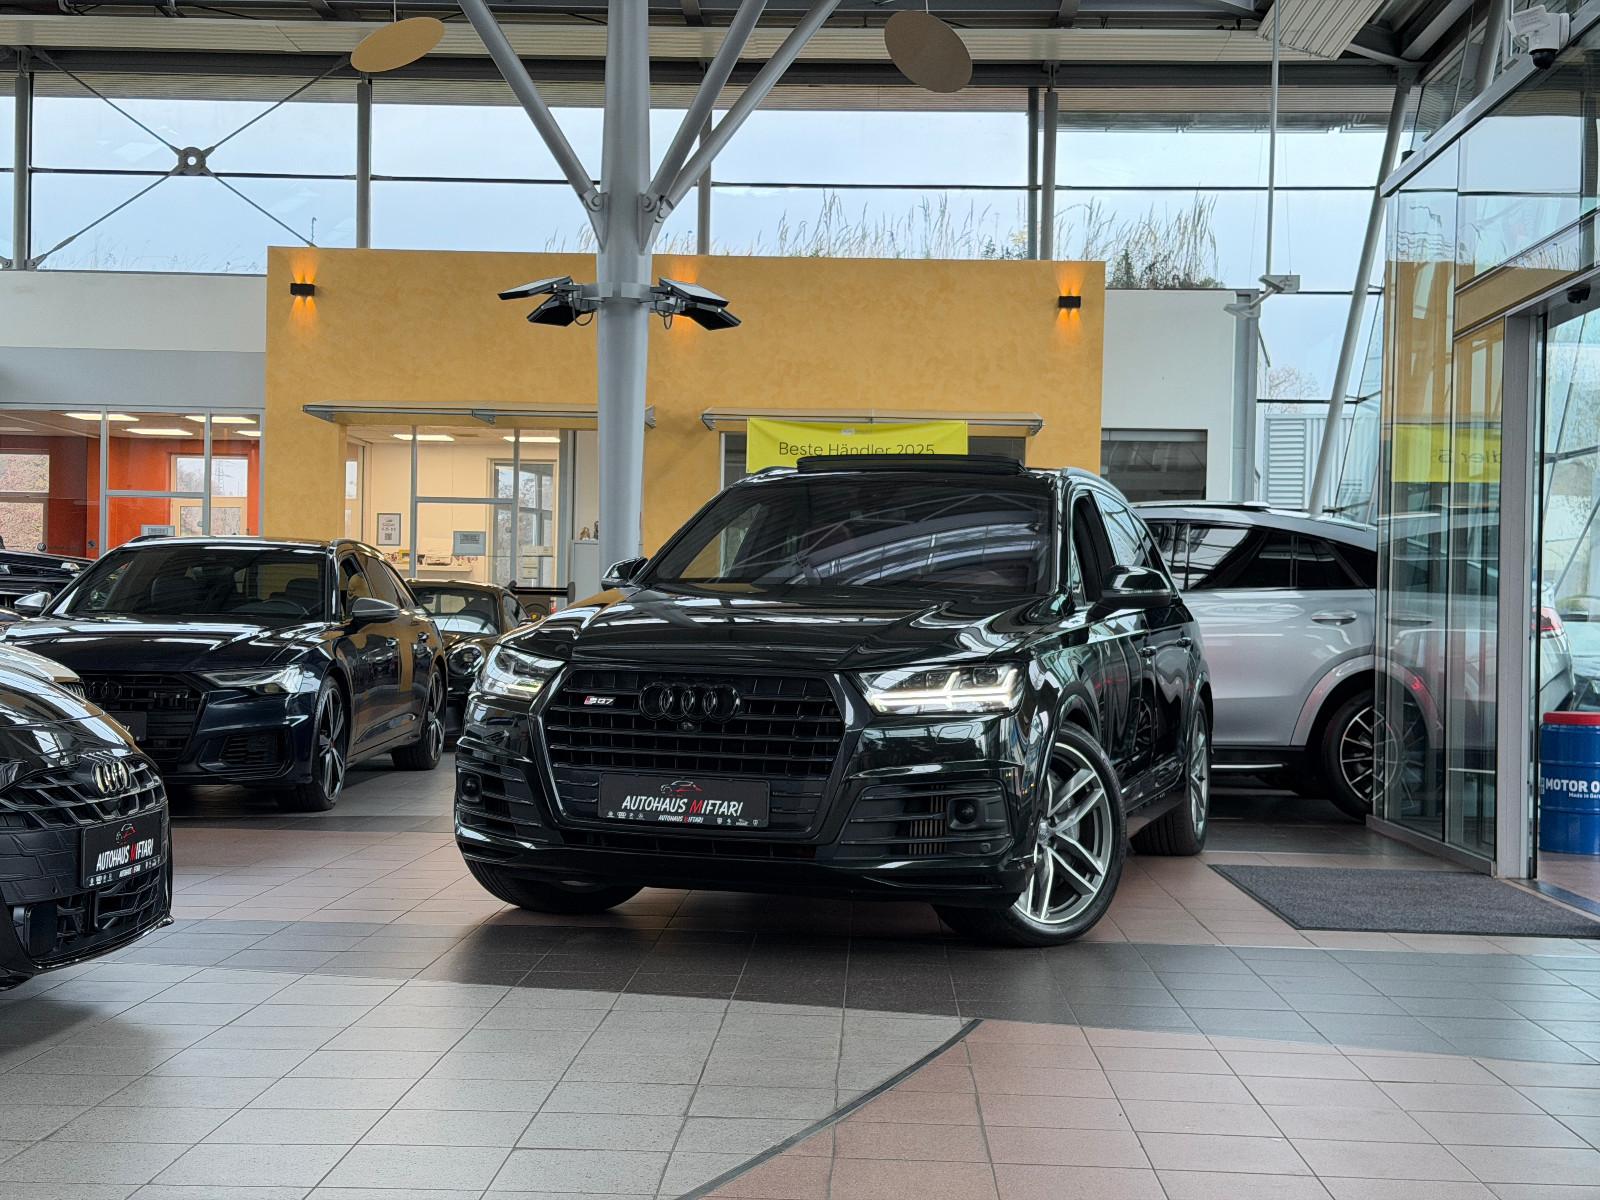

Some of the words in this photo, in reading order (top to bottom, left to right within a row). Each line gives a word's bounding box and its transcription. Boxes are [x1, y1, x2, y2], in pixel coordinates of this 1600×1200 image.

[779, 441, 823, 456] Beste
[828, 443, 892, 456] Händler
[896, 444, 936, 456] 2025
[1545, 778, 1588, 793] MOTOR
[621, 796, 688, 813] AUTOHAUS
[689, 799, 744, 817] MIFTARI
[96, 845, 130, 872] AUTOHAUS
[130, 838, 154, 862] MIFTARI
